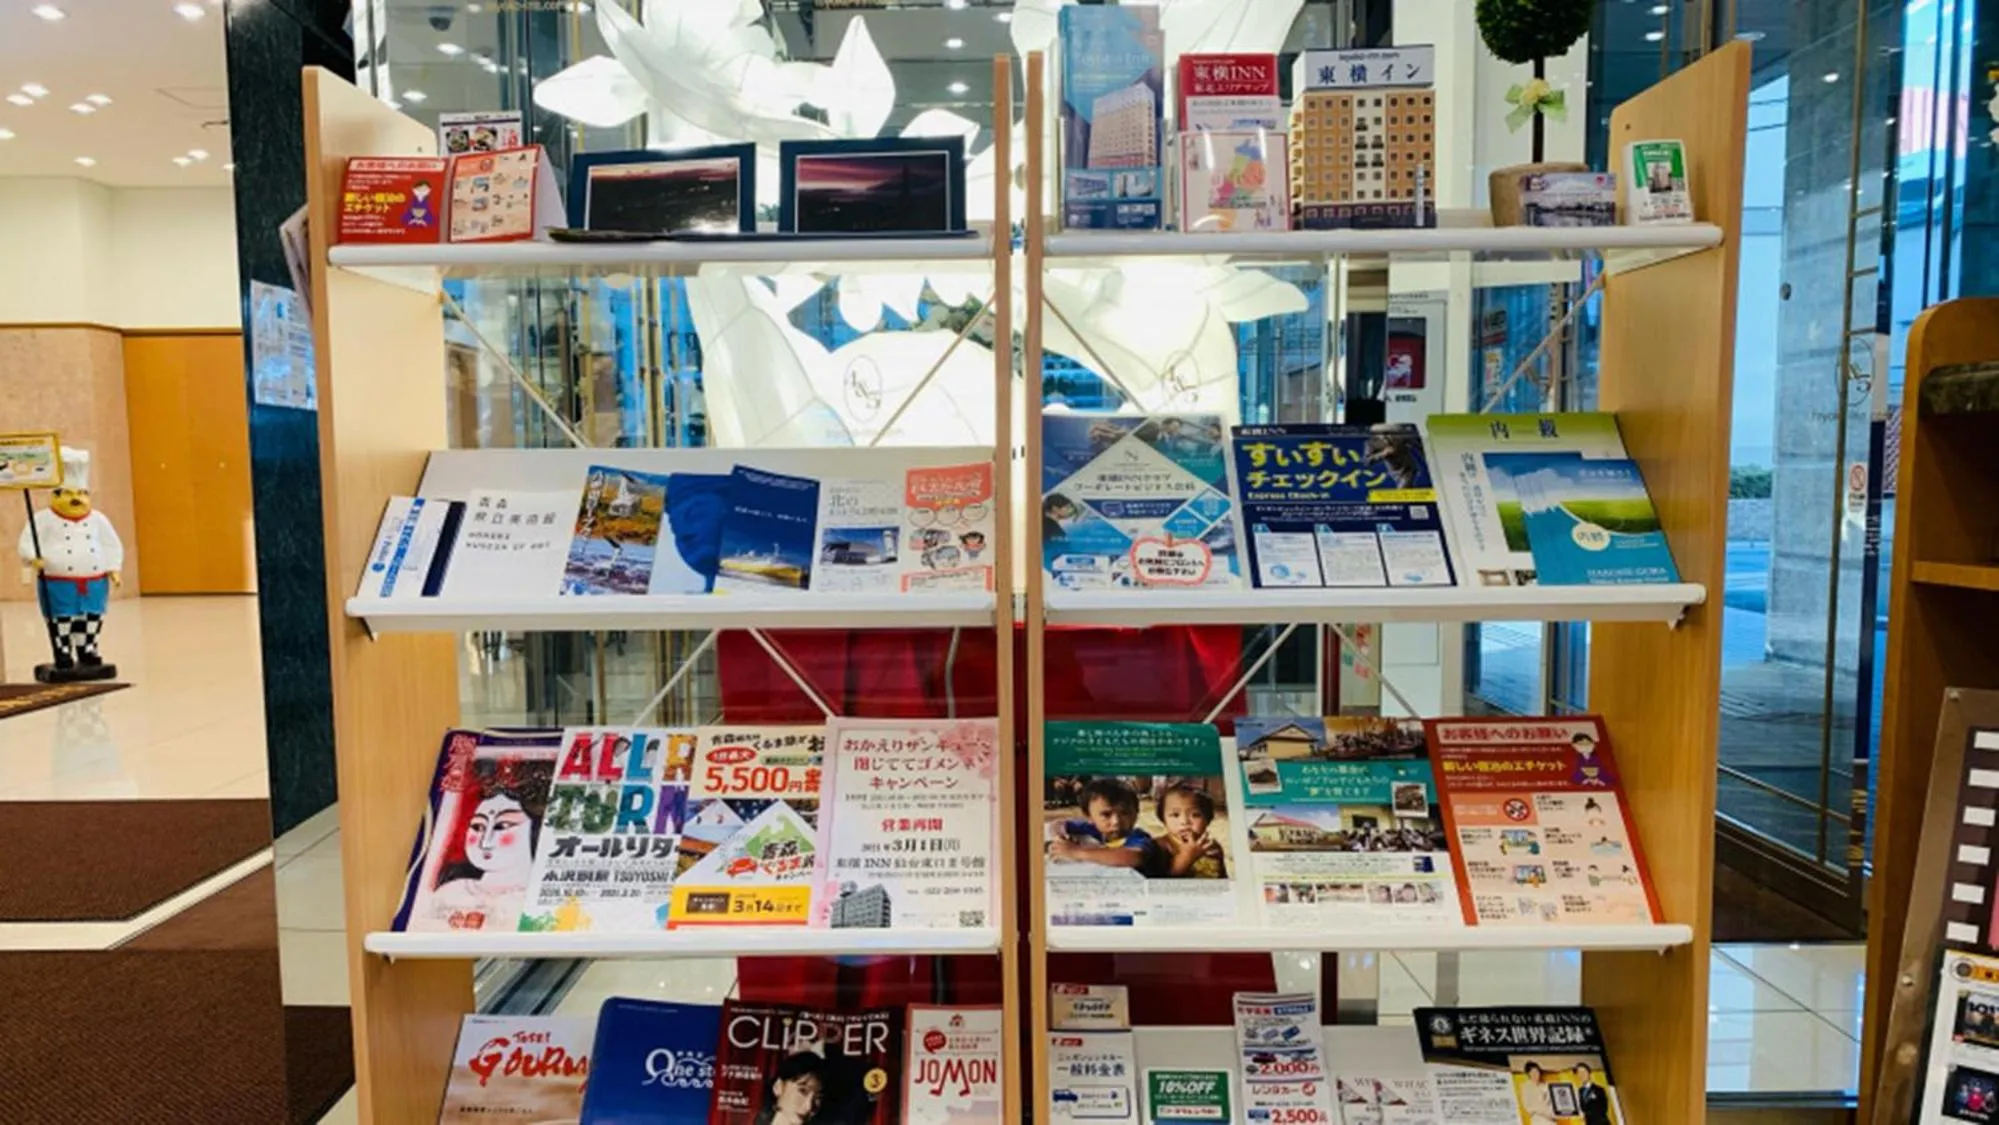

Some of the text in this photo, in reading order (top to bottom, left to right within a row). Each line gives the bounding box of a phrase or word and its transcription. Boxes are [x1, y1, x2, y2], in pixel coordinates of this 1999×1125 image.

[1193, 66, 1267, 79] 東横INN
[1317, 63, 1420, 84] 東横イン
[1242, 441, 1361, 467] すいすい
[1246, 469, 1387, 489] チェックイン
[1443, 727, 1569, 740] お客様へのお願い
[870, 776, 959, 791] キャンペーン
[546, 784, 690, 834] TURN
[882, 817, 943, 832] 営業再開
[548, 836, 679, 859] オールリタ
[914, 1058, 997, 1097] JOMON
[1057, 1063, 1126, 1077] 一般料金表
[1159, 1081, 1216, 1094] 10%OFF
